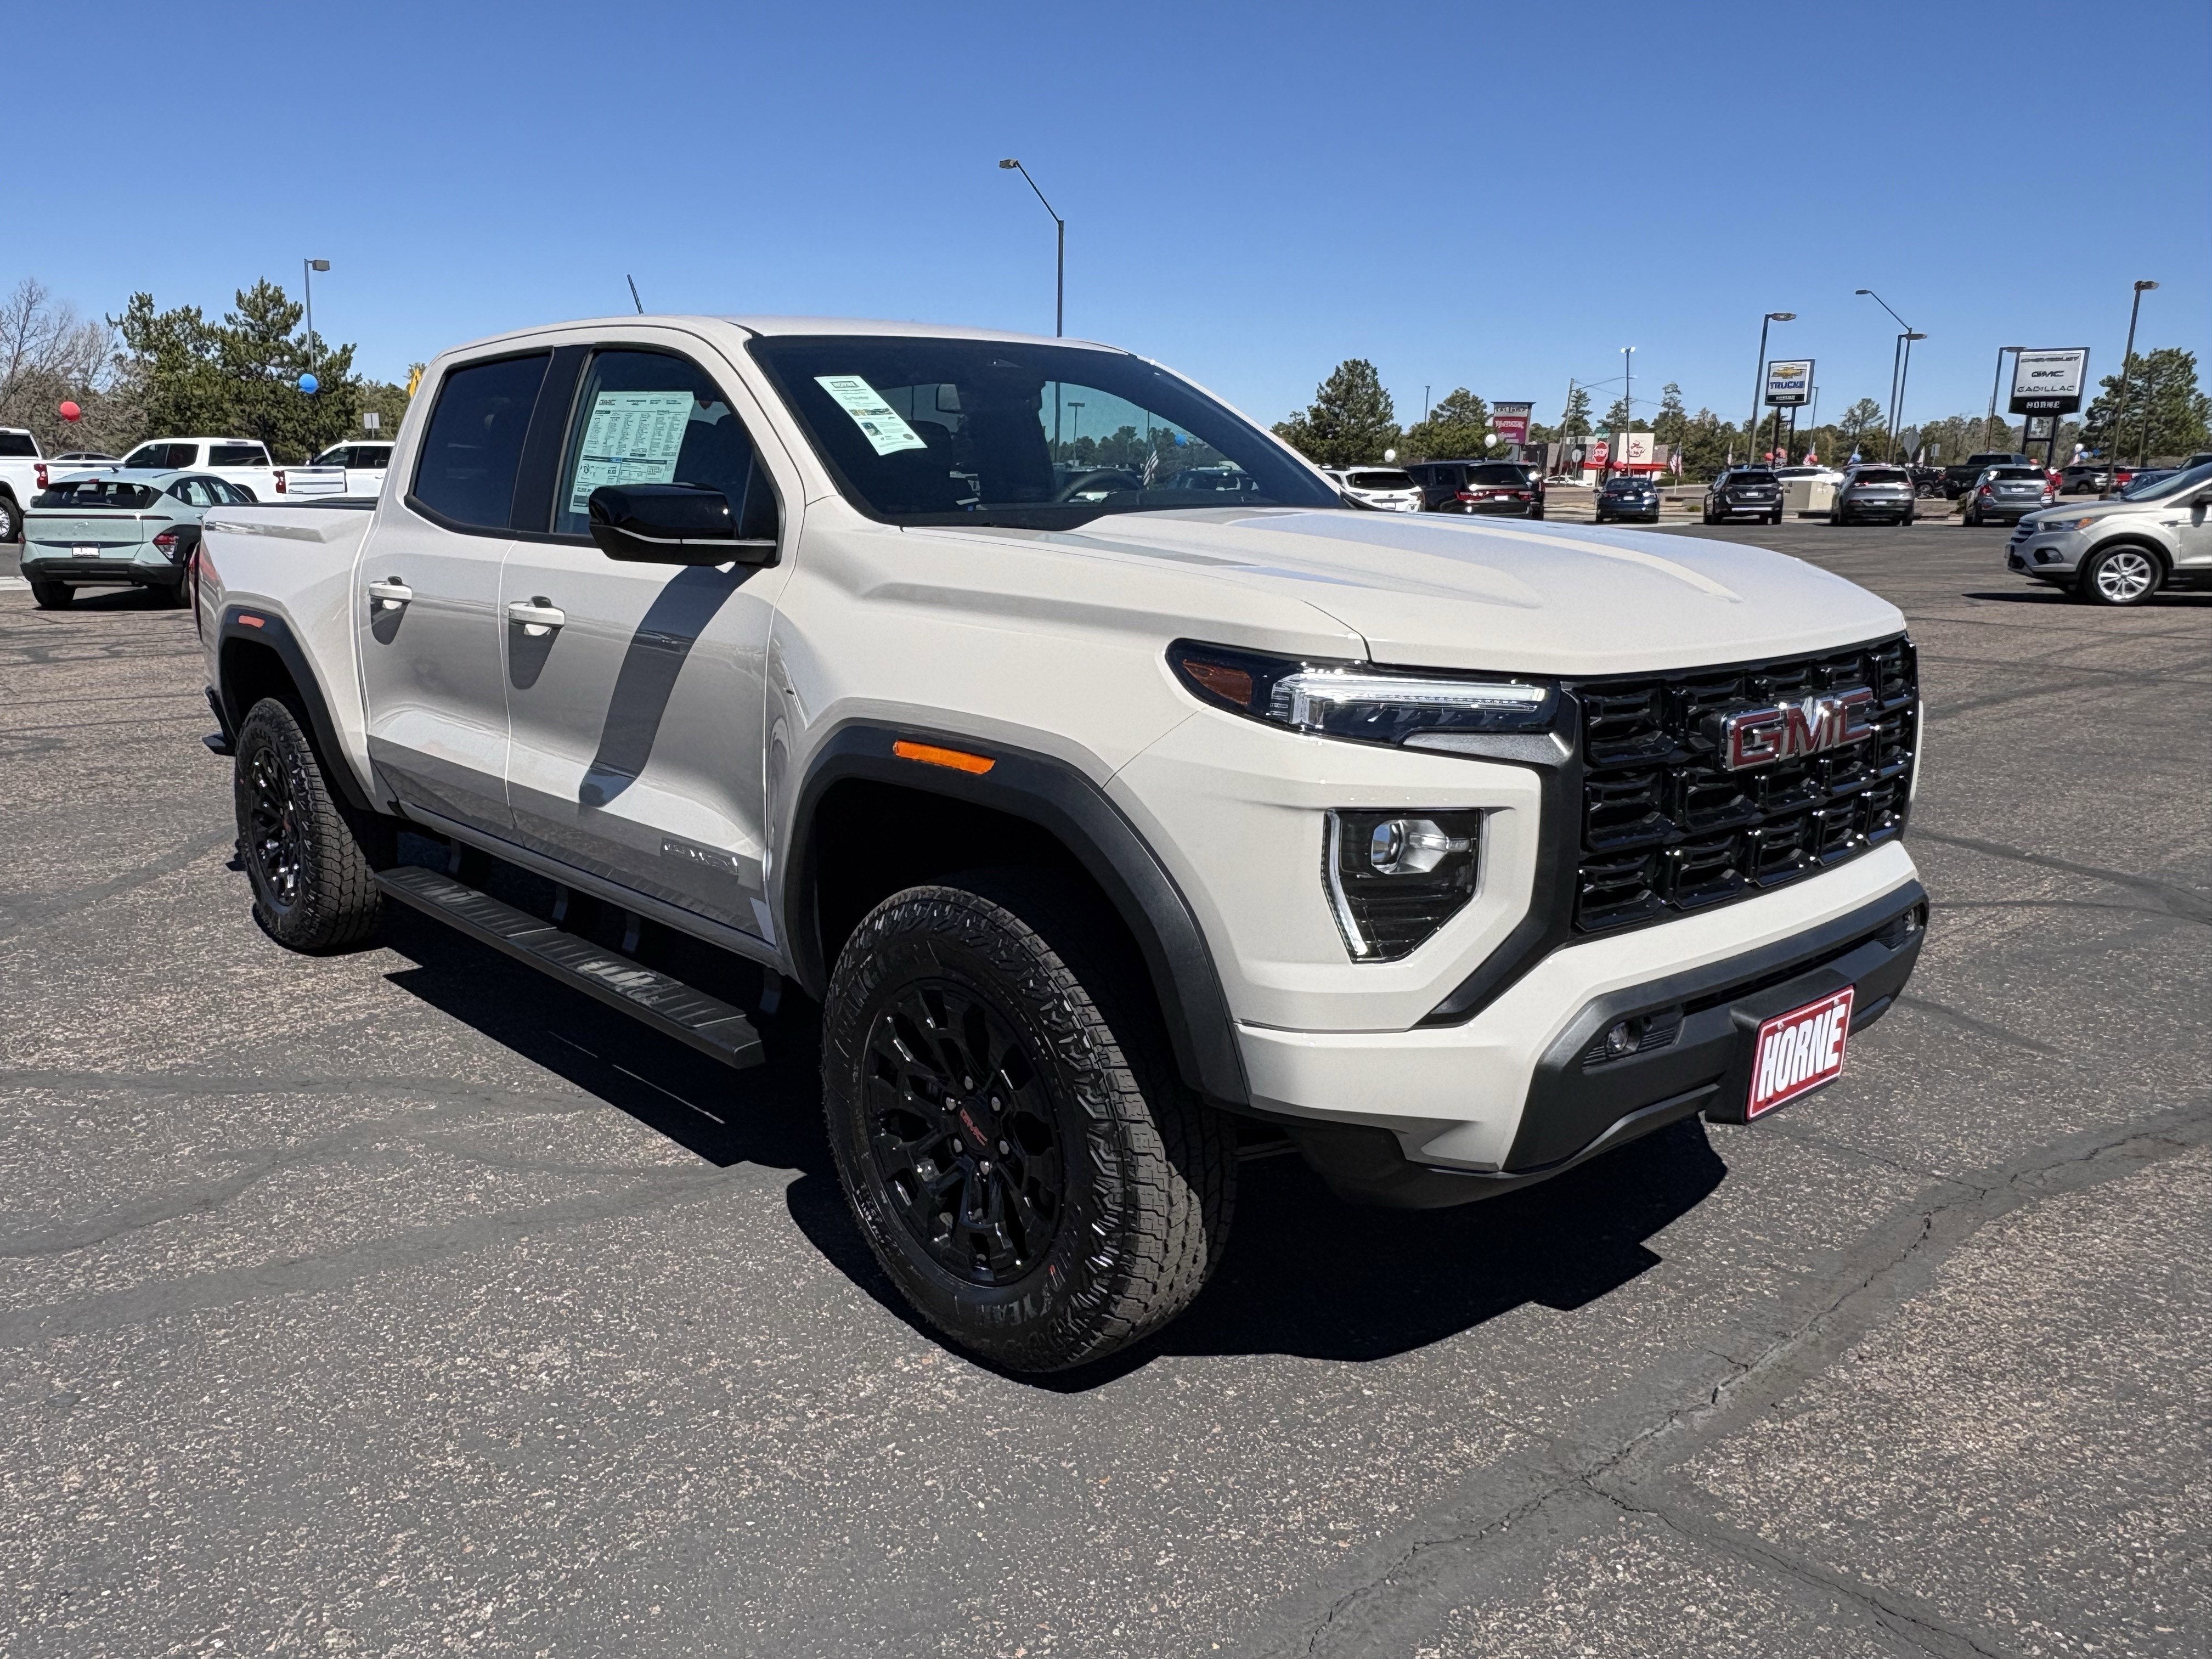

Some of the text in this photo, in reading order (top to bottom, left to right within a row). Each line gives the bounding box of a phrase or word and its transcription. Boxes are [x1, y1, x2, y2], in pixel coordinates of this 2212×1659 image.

[1720, 687, 1874, 771] GMC
[1757, 1003, 1847, 1102] HORNE
[960, 1107, 989, 1147] GMC
